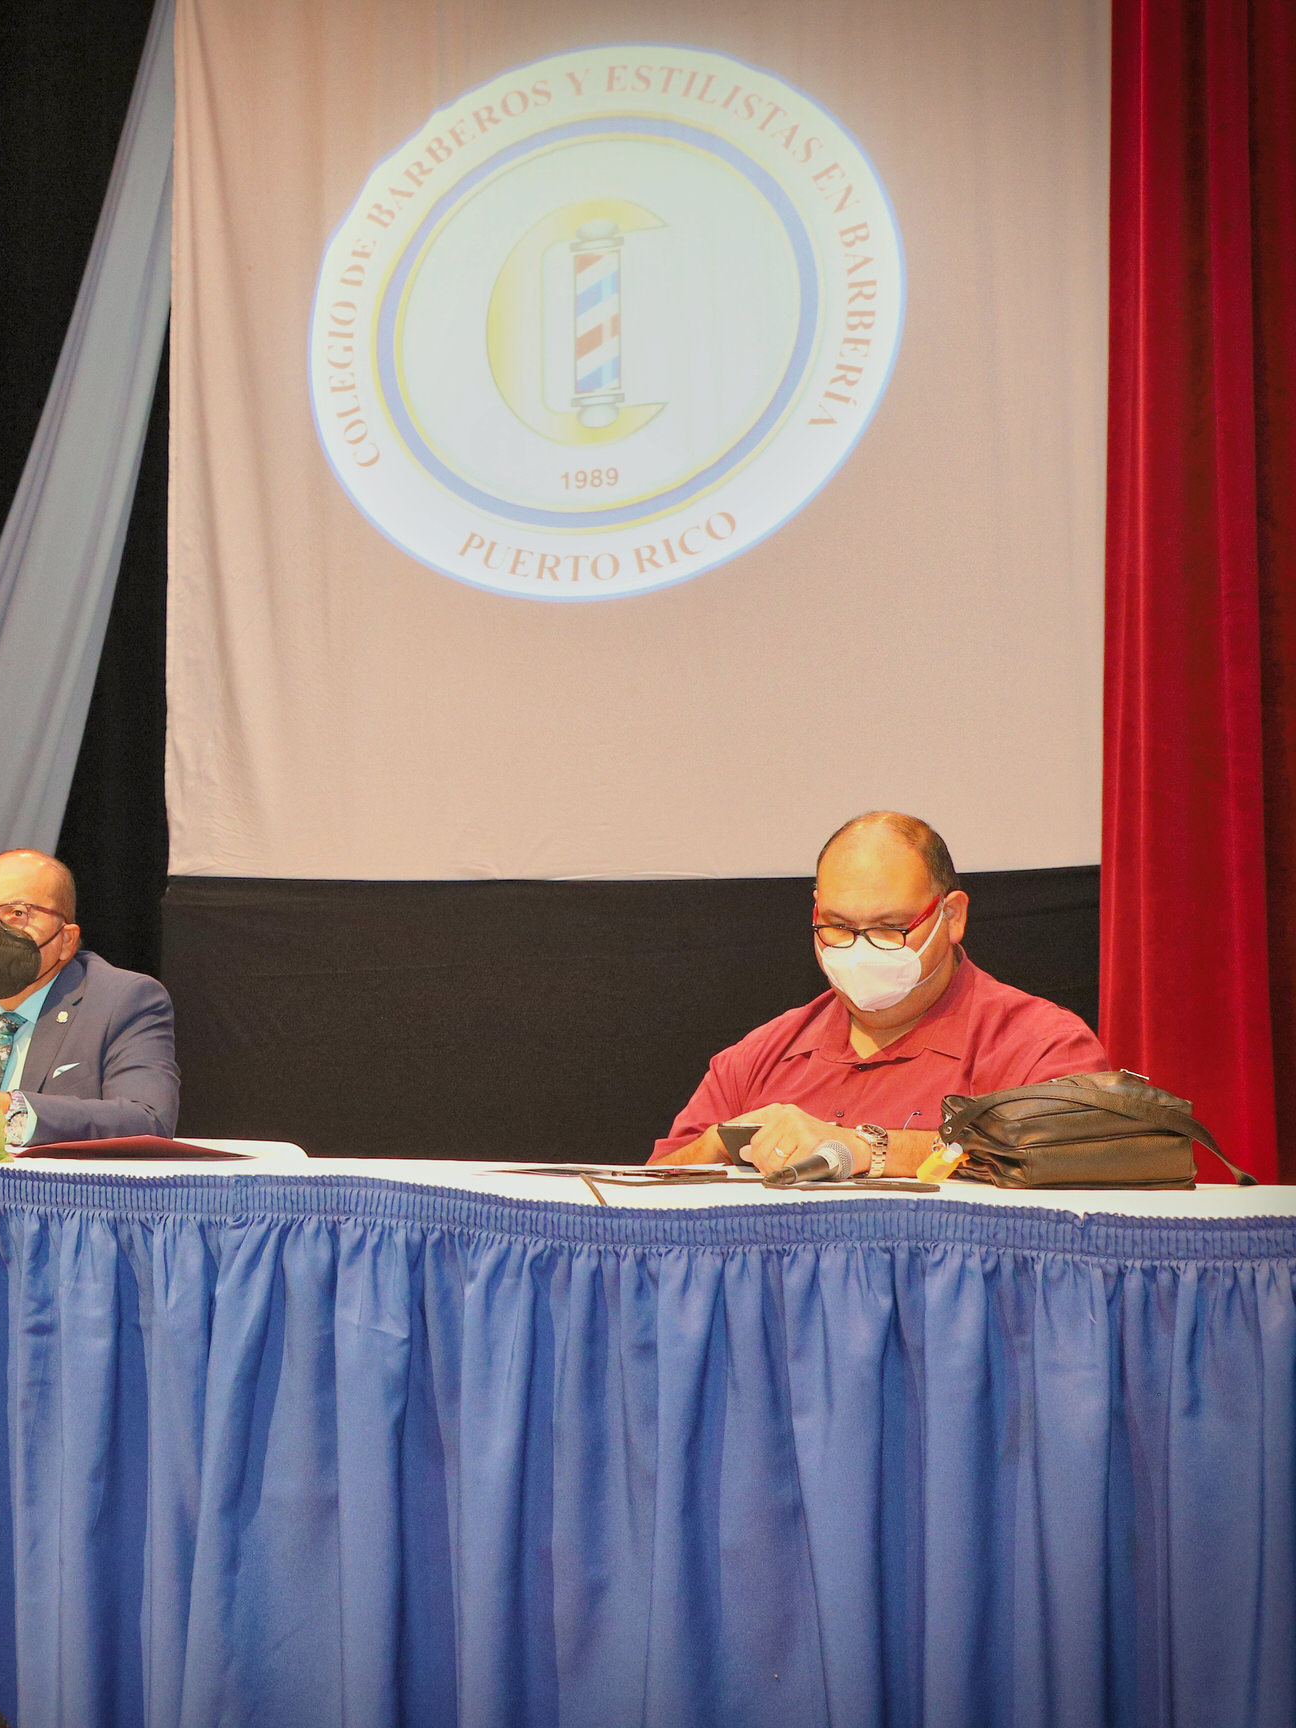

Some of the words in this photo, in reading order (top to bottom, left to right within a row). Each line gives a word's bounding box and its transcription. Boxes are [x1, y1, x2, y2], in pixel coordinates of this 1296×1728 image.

[565, 68, 592, 97] Y
[605, 64, 824, 164] ESTILISTAS
[365, 79, 553, 230] BARBEROS
[811, 161, 861, 215] EN
[339, 238, 377, 287] DE
[807, 221, 878, 426] BARBERÍA
[327, 301, 380, 467] COLEGIO
[560, 467, 620, 491] 1989
[457, 531, 621, 583] PUERTO
[632, 511, 737, 575] RICO
